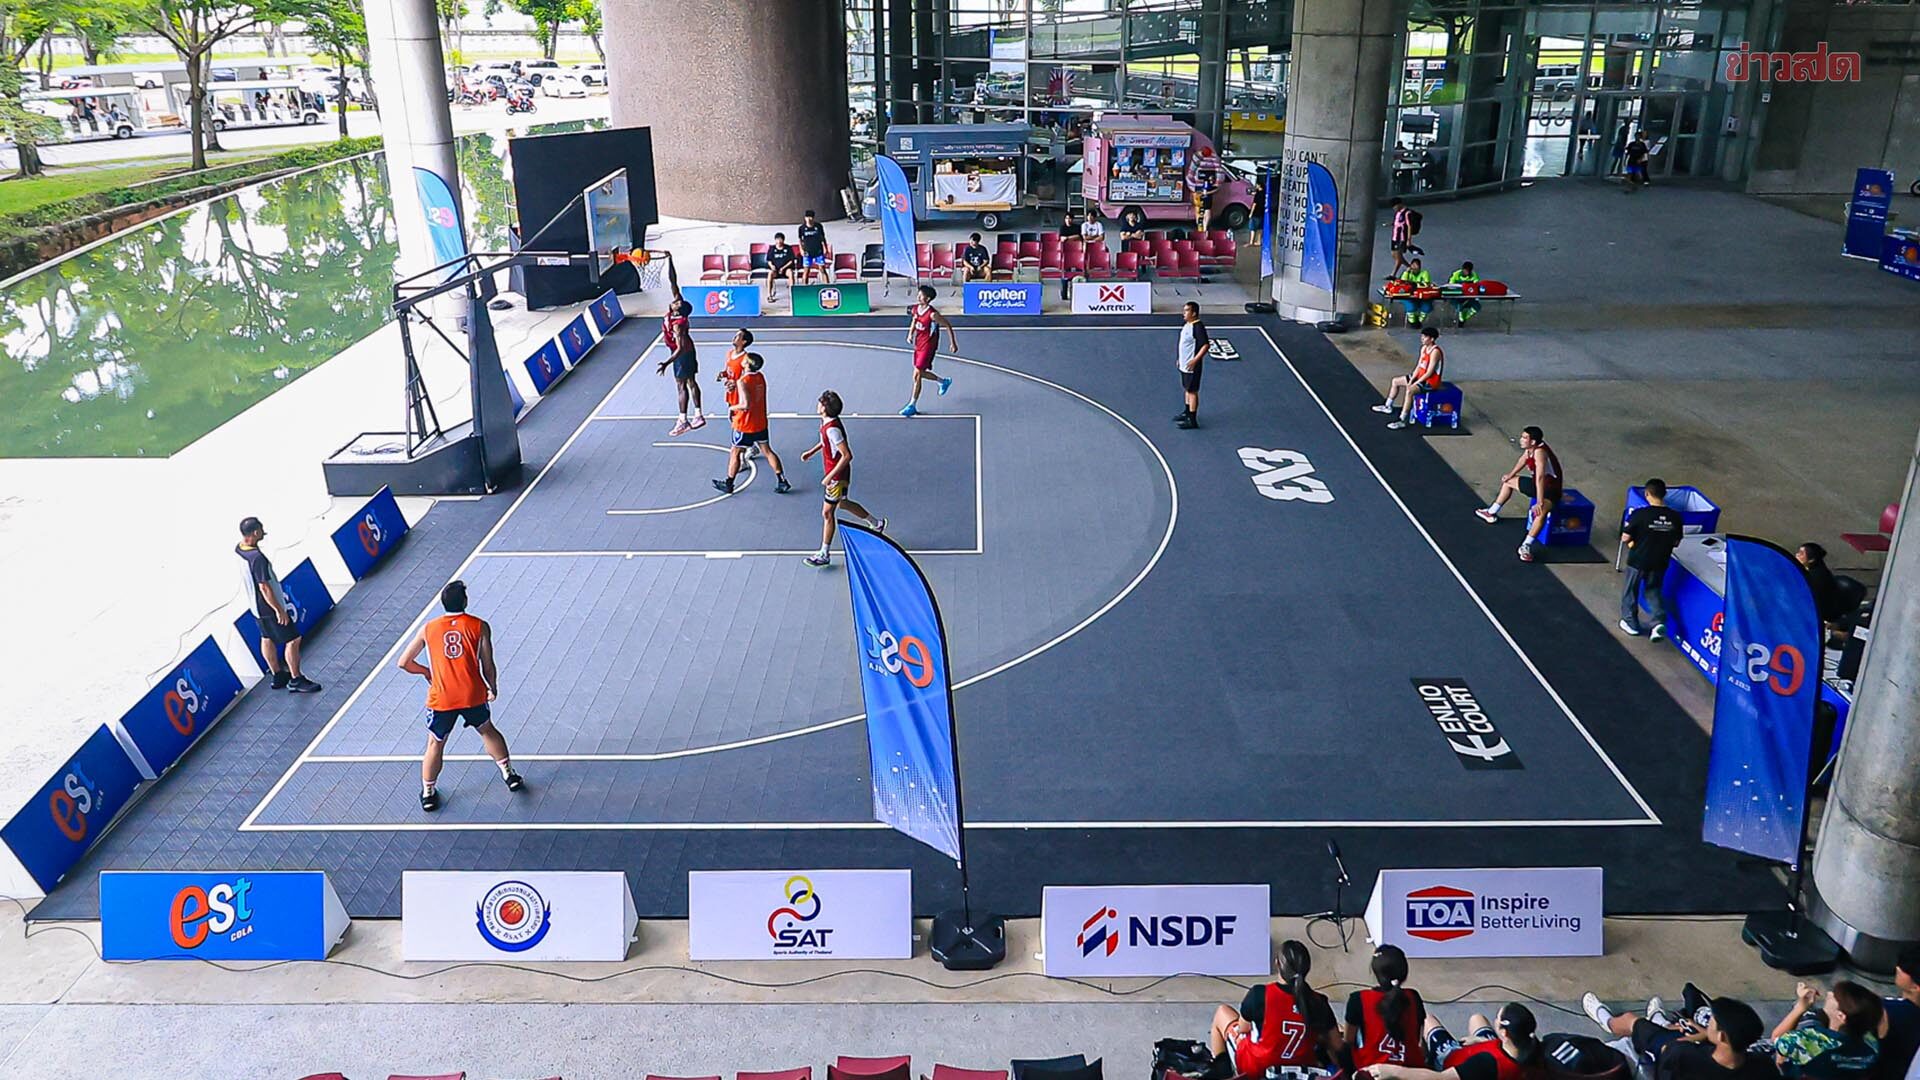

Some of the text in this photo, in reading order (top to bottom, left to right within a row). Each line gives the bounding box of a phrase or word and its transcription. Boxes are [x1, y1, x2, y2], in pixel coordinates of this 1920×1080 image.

[1296, 166, 1308, 178] UP
[704, 290, 734, 314] est
[978, 288, 1027, 300] molten
[1088, 304, 1135, 312] WARRIX
[444, 630, 463, 659] 8
[1418, 685, 1468, 733] ENLIO
[1443, 685, 1495, 733] COURT
[169, 877, 252, 950] est
[1409, 902, 1472, 925] TOA
[1481, 893, 1549, 914] Inspire
[230, 925, 253, 942] COLA
[774, 929, 834, 947] SAT
[1129, 916, 1237, 947] NSDF
[1281, 1020, 1307, 1060] 7
